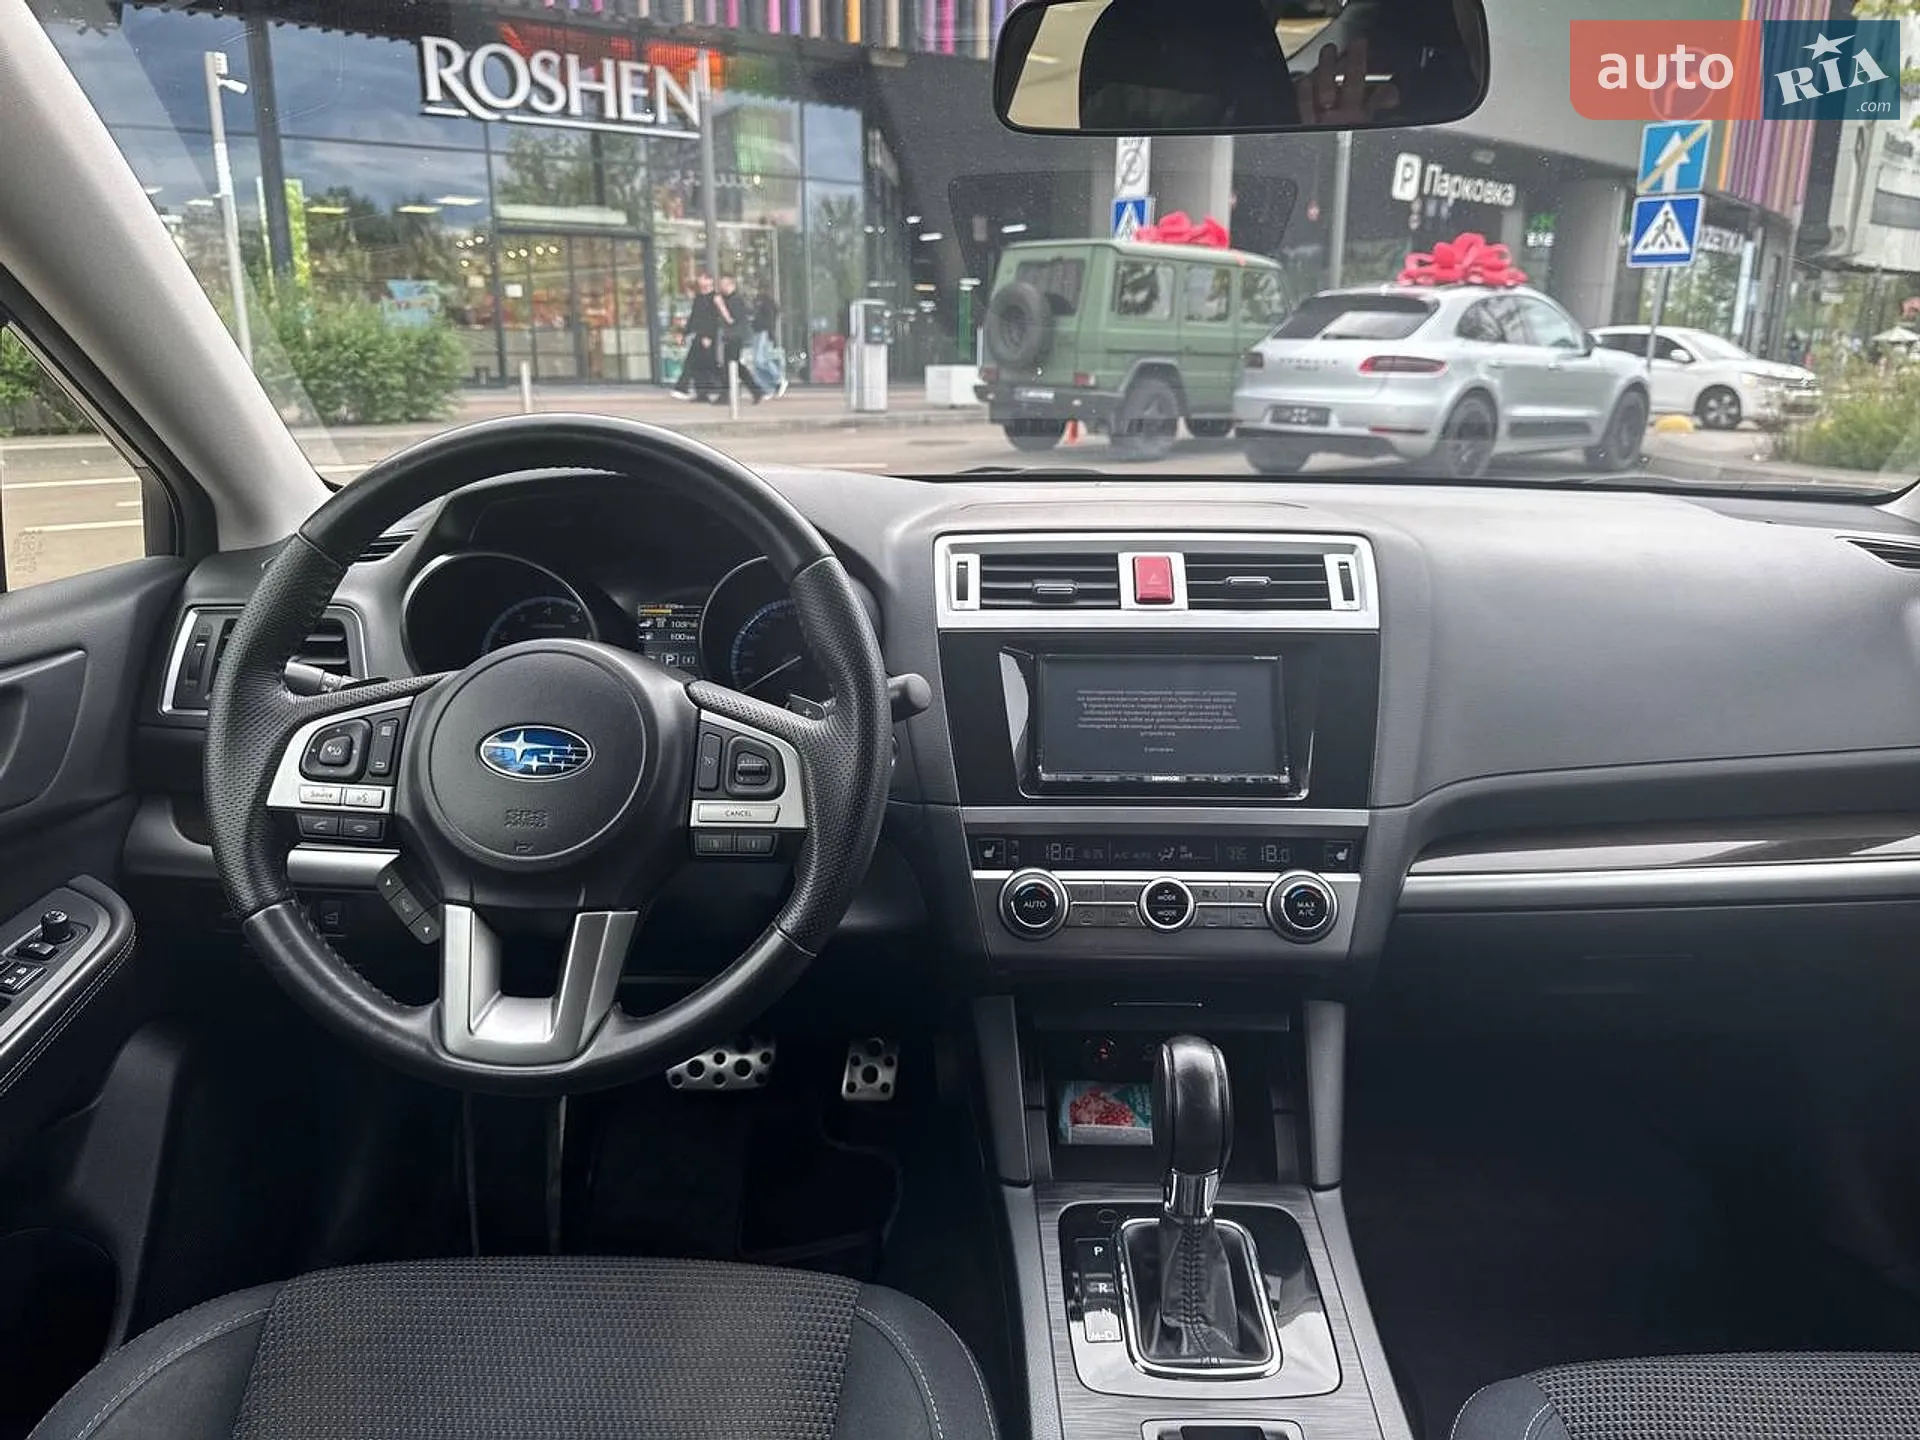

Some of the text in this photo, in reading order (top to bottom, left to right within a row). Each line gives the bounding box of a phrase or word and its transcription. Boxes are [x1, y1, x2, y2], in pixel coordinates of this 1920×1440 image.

[420, 35, 702, 128] ROSHEN
[1423, 163, 1516, 207] Парковка
[1023, 900, 1048, 909] AUTO
[1093, 1246, 1104, 1256] P
[1098, 1282, 1109, 1293] R
